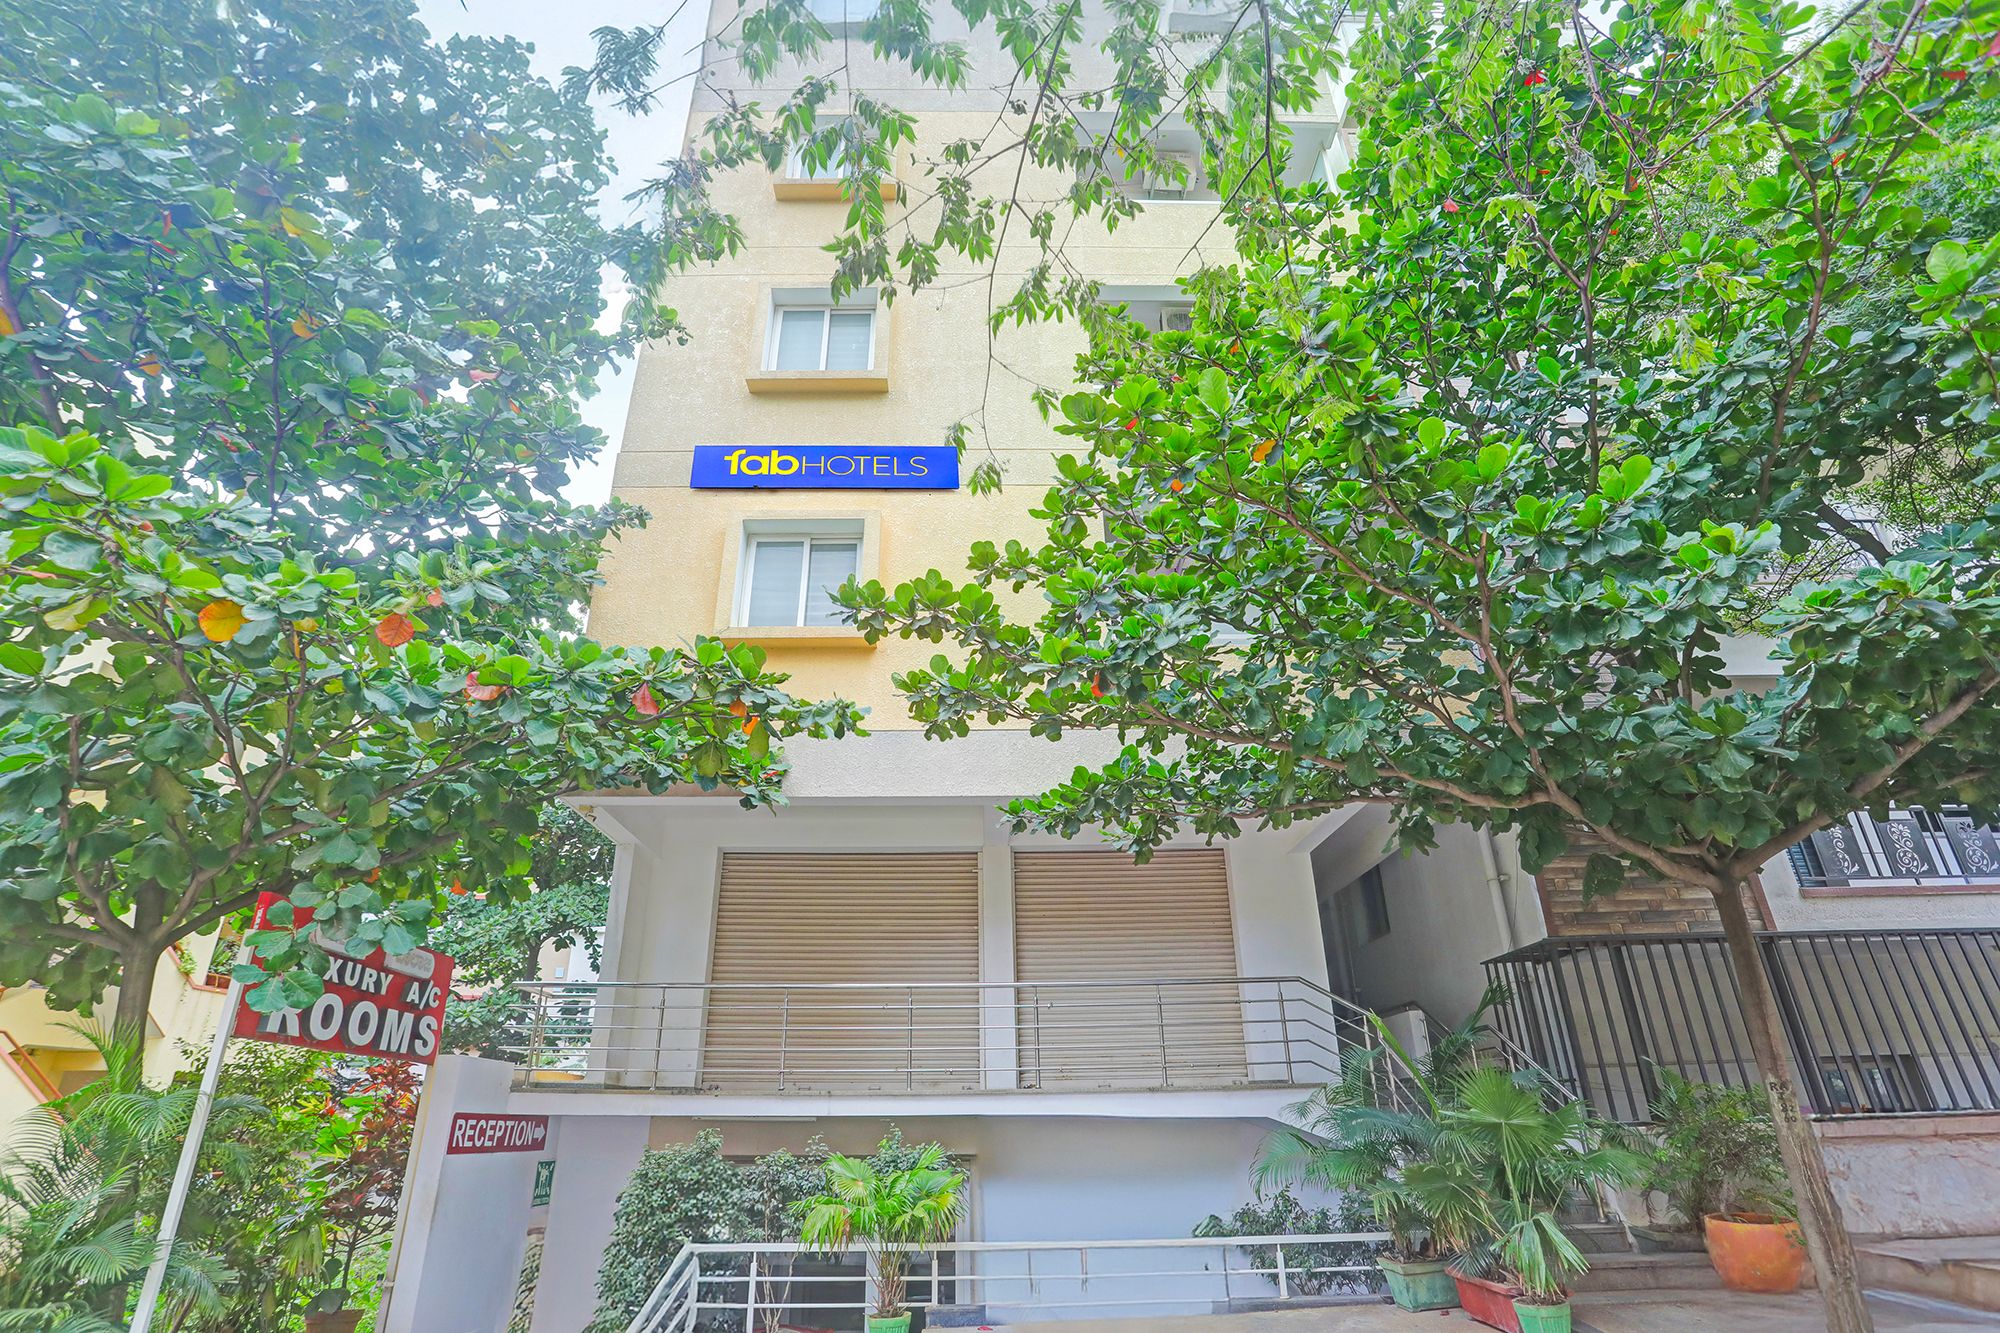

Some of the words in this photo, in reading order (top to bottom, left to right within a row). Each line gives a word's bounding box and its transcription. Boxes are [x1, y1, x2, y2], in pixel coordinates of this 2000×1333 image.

[320, 955, 393, 995] XURY
[406, 979, 442, 1010] A/C
[452, 1119, 535, 1147] RECEPTION
